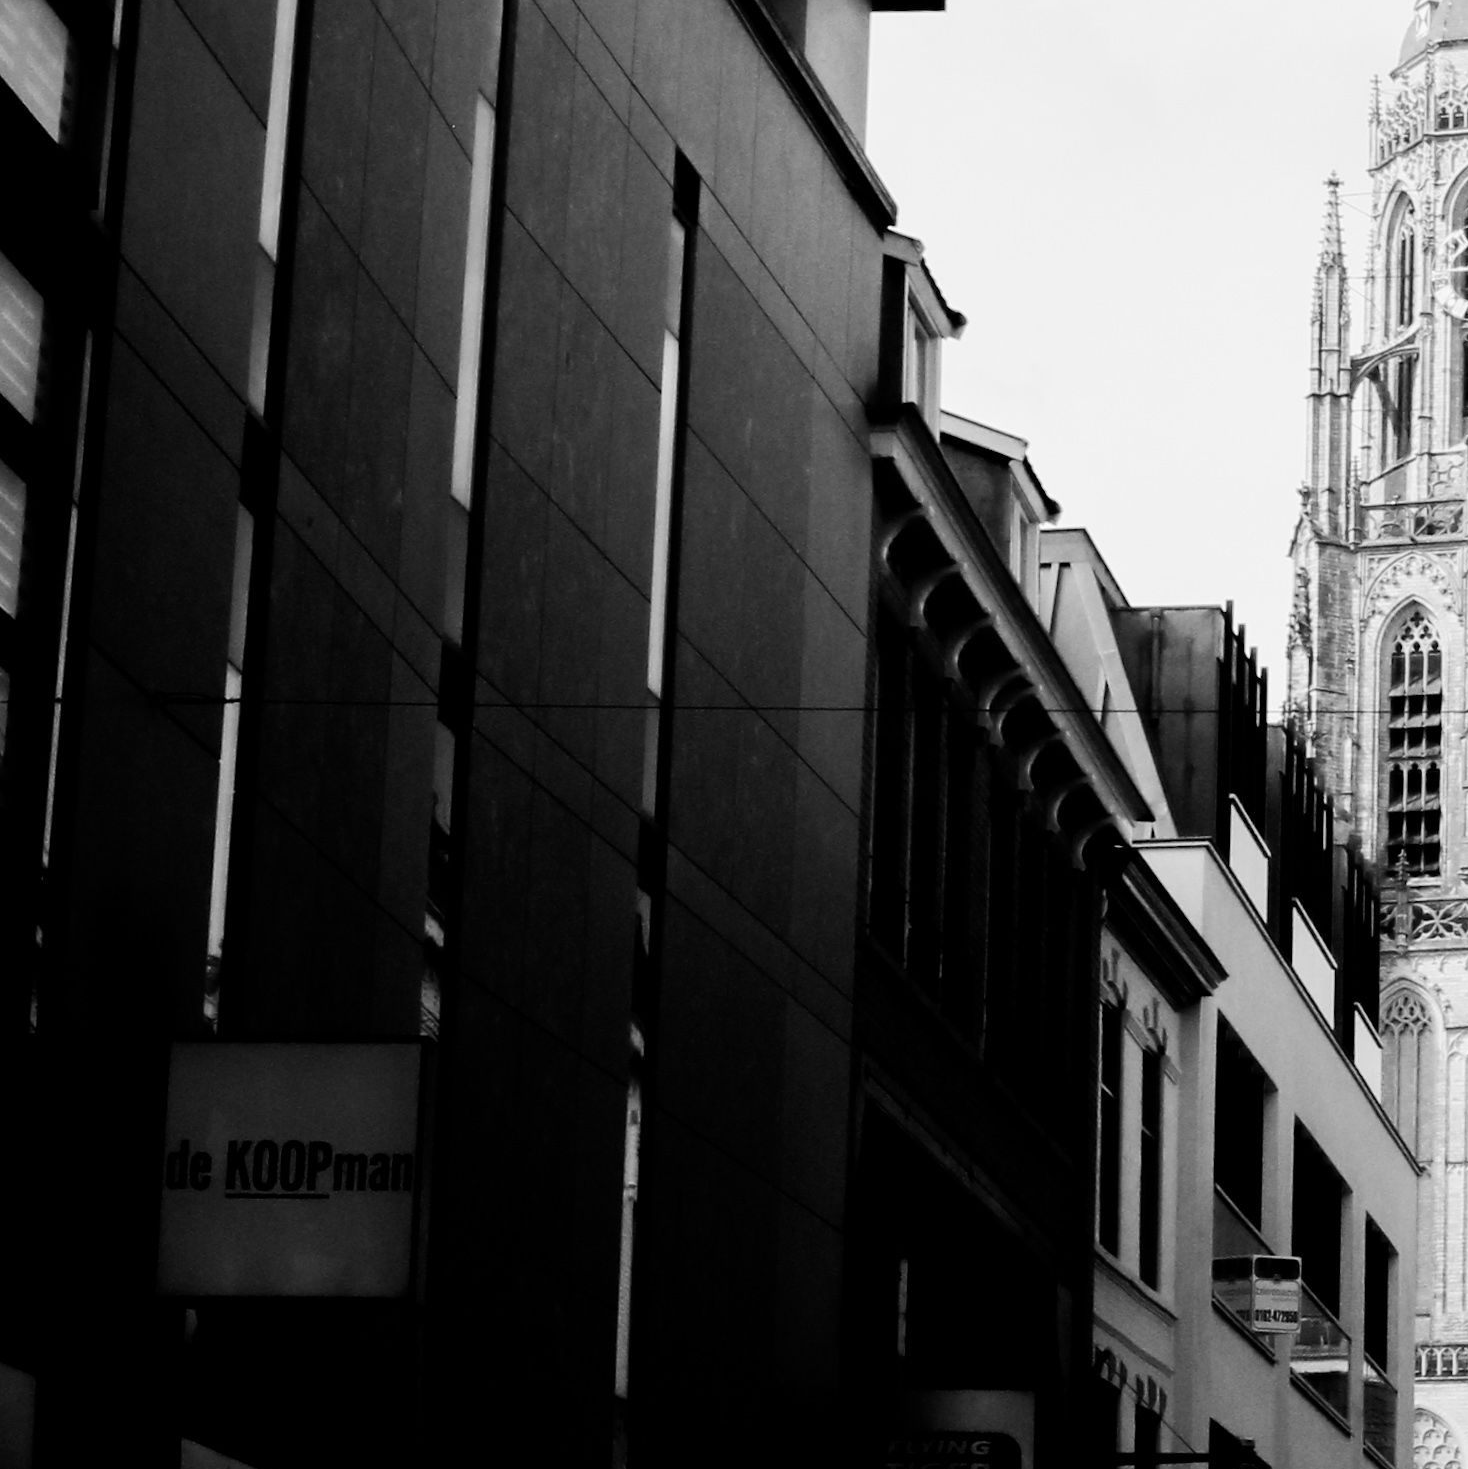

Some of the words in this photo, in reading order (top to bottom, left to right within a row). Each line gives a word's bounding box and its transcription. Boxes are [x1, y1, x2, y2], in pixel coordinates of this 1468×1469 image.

[165, 1139, 212, 1190] de
[225, 1139, 413, 1192] KOOPman
[888, 1440, 992, 1455] FLYING
